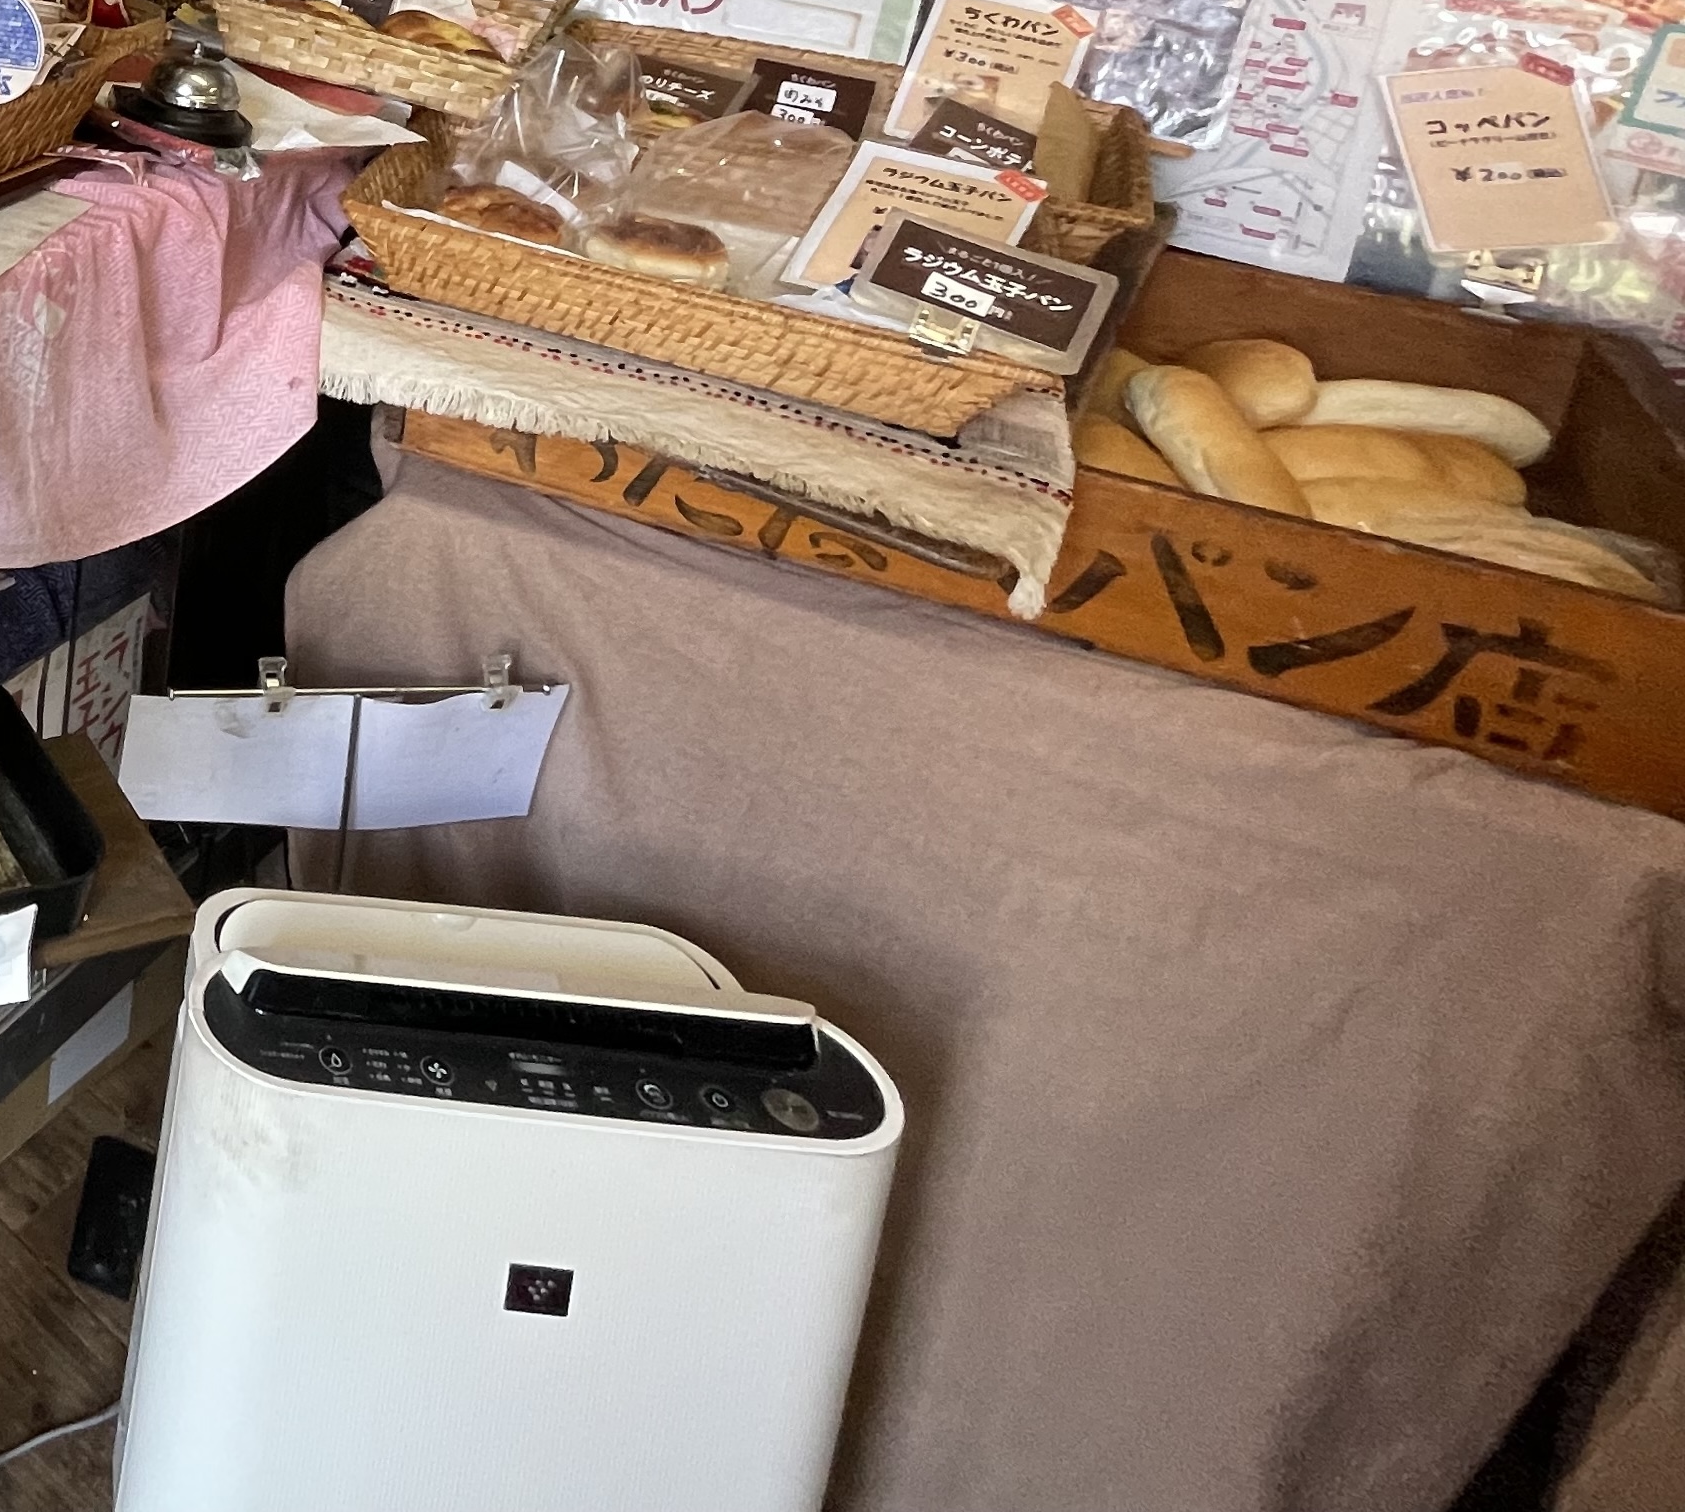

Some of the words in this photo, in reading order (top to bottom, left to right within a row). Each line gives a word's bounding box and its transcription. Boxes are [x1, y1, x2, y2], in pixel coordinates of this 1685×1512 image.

[964, 5, 1060, 37] ちくわパン
[1424, 111, 1551, 135] コッペパン
[902, 246, 1074, 312] ラジウム玉子パン
[927, 279, 979, 309] 300
